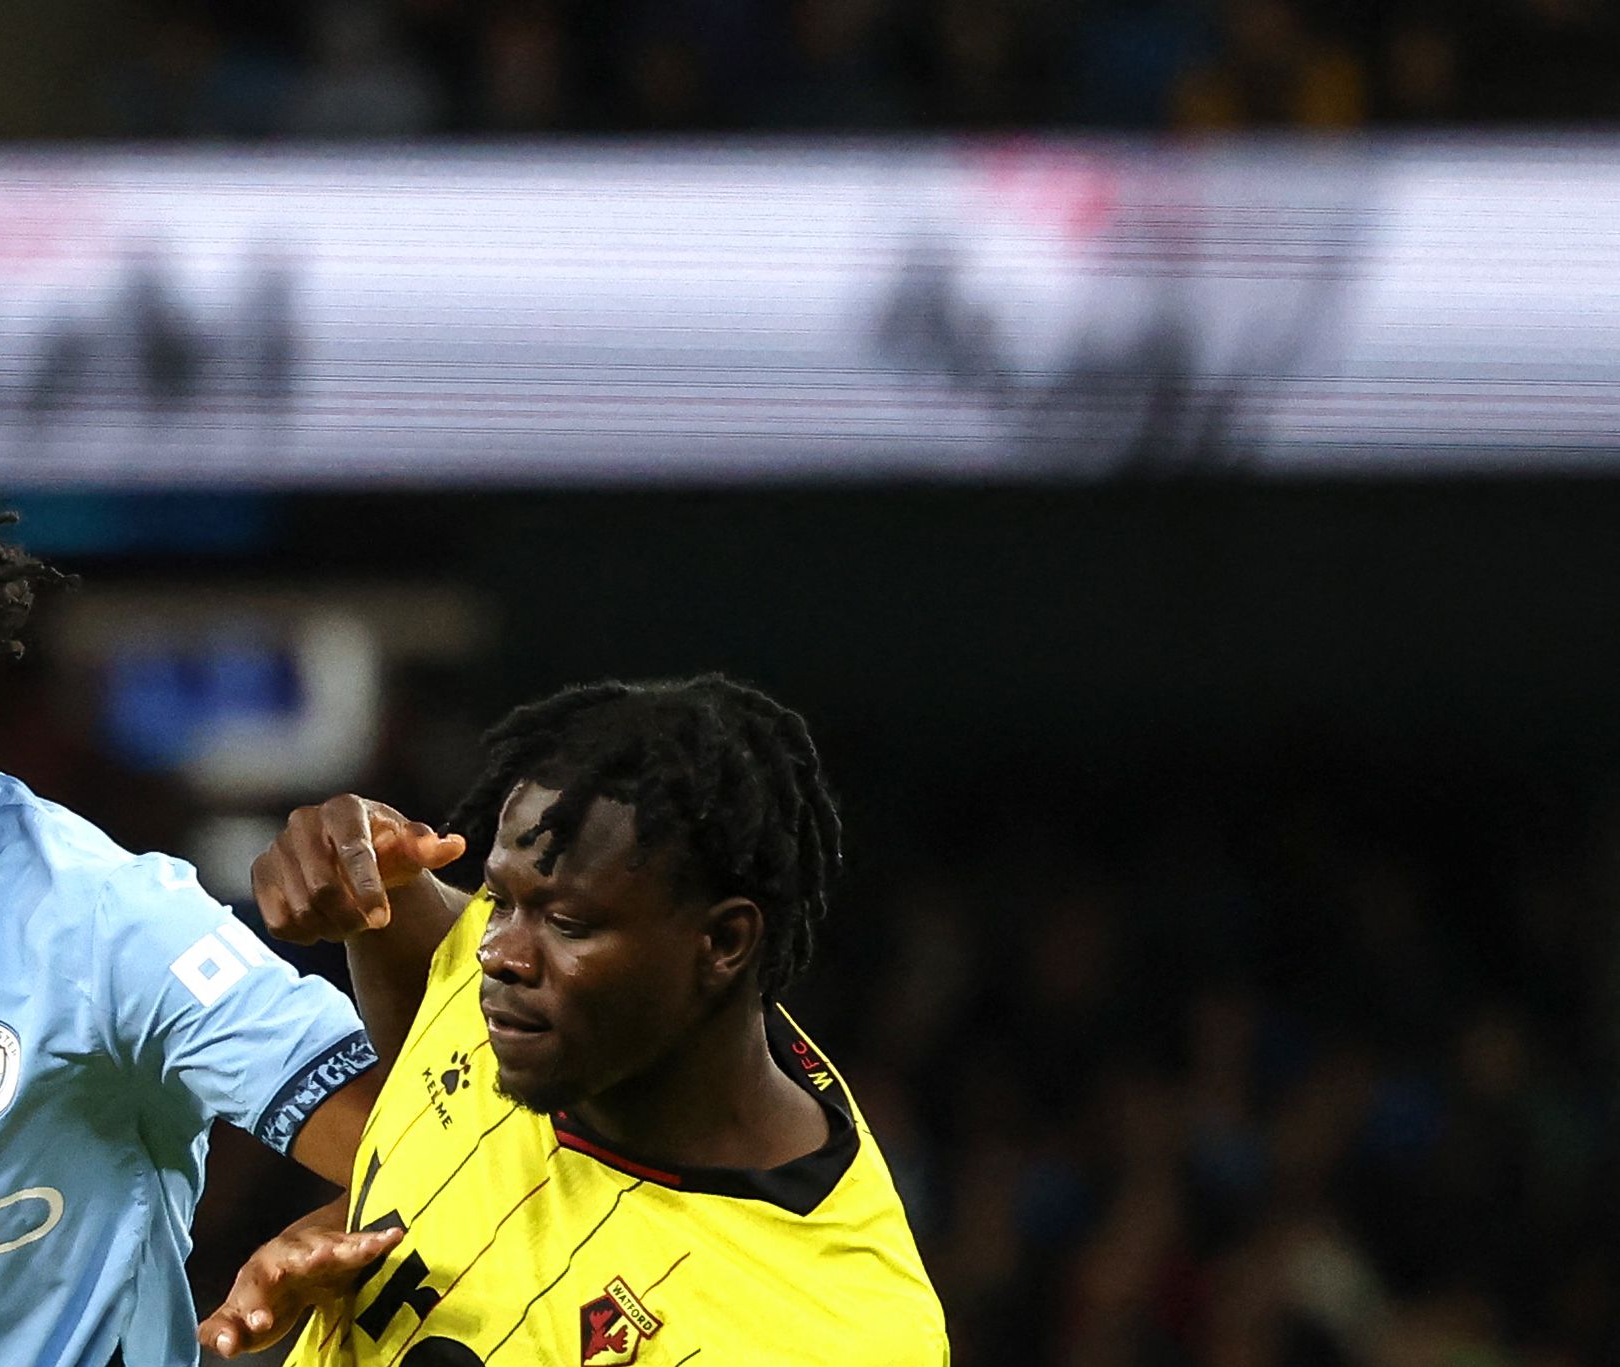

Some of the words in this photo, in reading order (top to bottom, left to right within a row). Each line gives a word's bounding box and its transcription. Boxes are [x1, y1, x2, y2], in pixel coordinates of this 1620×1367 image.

[791, 1040, 834, 1092] WFC
[422, 1067, 453, 1130] KELME
[612, 1284, 653, 1331] WATFORD
